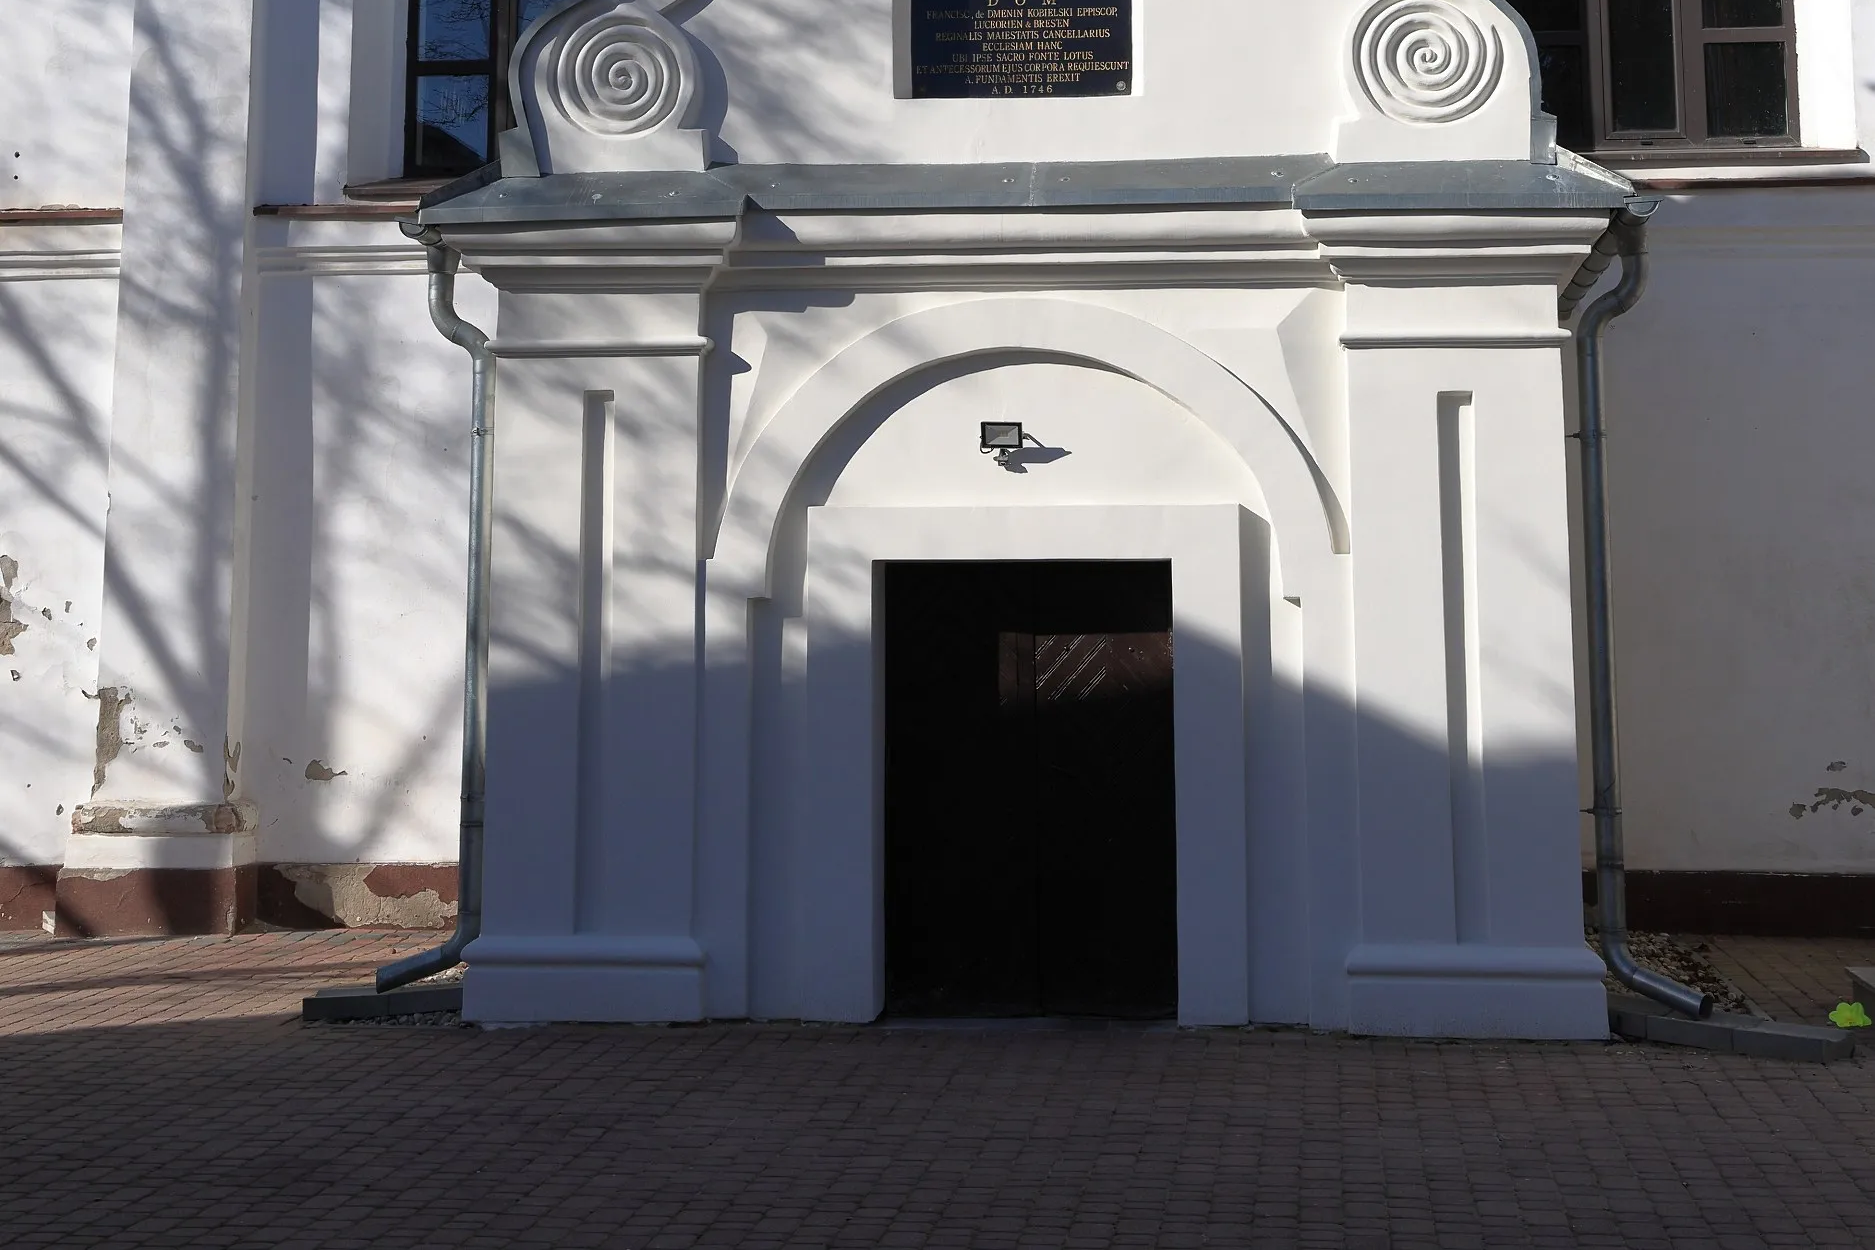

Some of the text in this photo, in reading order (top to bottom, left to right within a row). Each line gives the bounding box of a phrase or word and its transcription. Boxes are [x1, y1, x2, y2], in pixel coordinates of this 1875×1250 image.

[976, 10, 984, 19] de
[1028, 8, 1072, 17] KOBIELSKI
[1043, 29, 1110, 39] CANCELLARIUS
[983, 41, 1063, 51] ECCLESIAM HANC
[952, 51, 1094, 62] UBI IPSE SACRO FONTE LOTUS
[1002, 64, 1022, 73] EJUS
[1025, 63, 1064, 72] CORPORA
[1068, 61, 1129, 71] REQUIESCUNT
[976, 74, 1042, 84] FUNDAMENTIS
[1047, 73, 1080, 82] EREXIT
[1023, 85, 1053, 93] 1746
